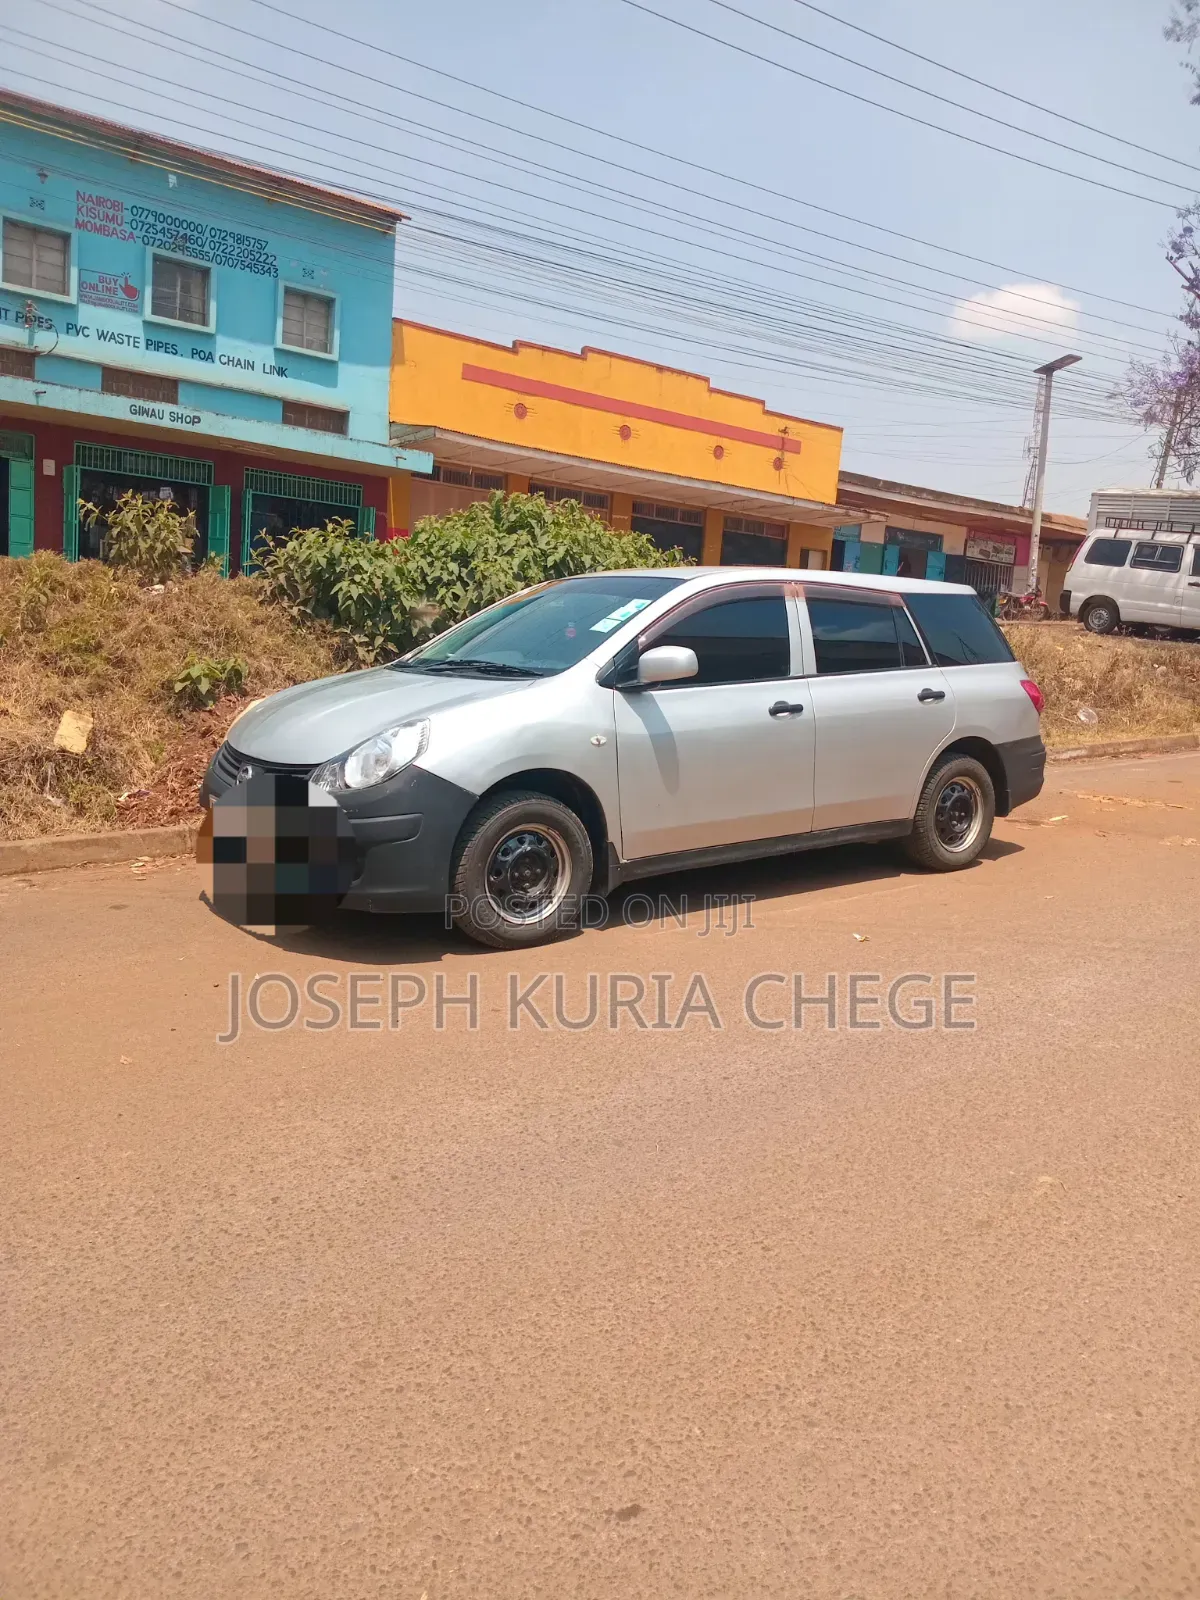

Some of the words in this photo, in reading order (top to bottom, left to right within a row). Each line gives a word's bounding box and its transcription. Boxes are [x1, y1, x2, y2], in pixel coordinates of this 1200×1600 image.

[80, 281, 119, 296] ONLINE
[98, 275, 119, 286] BUY
[66, 322, 90, 338] PVC
[96, 328, 141, 349] WASTE
[191, 347, 215, 363] POA
[218, 354, 255, 371] CHAIN
[262, 363, 288, 378] LINK
[129, 404, 165, 420] GIWAU
[169, 411, 202, 426] SHOP
